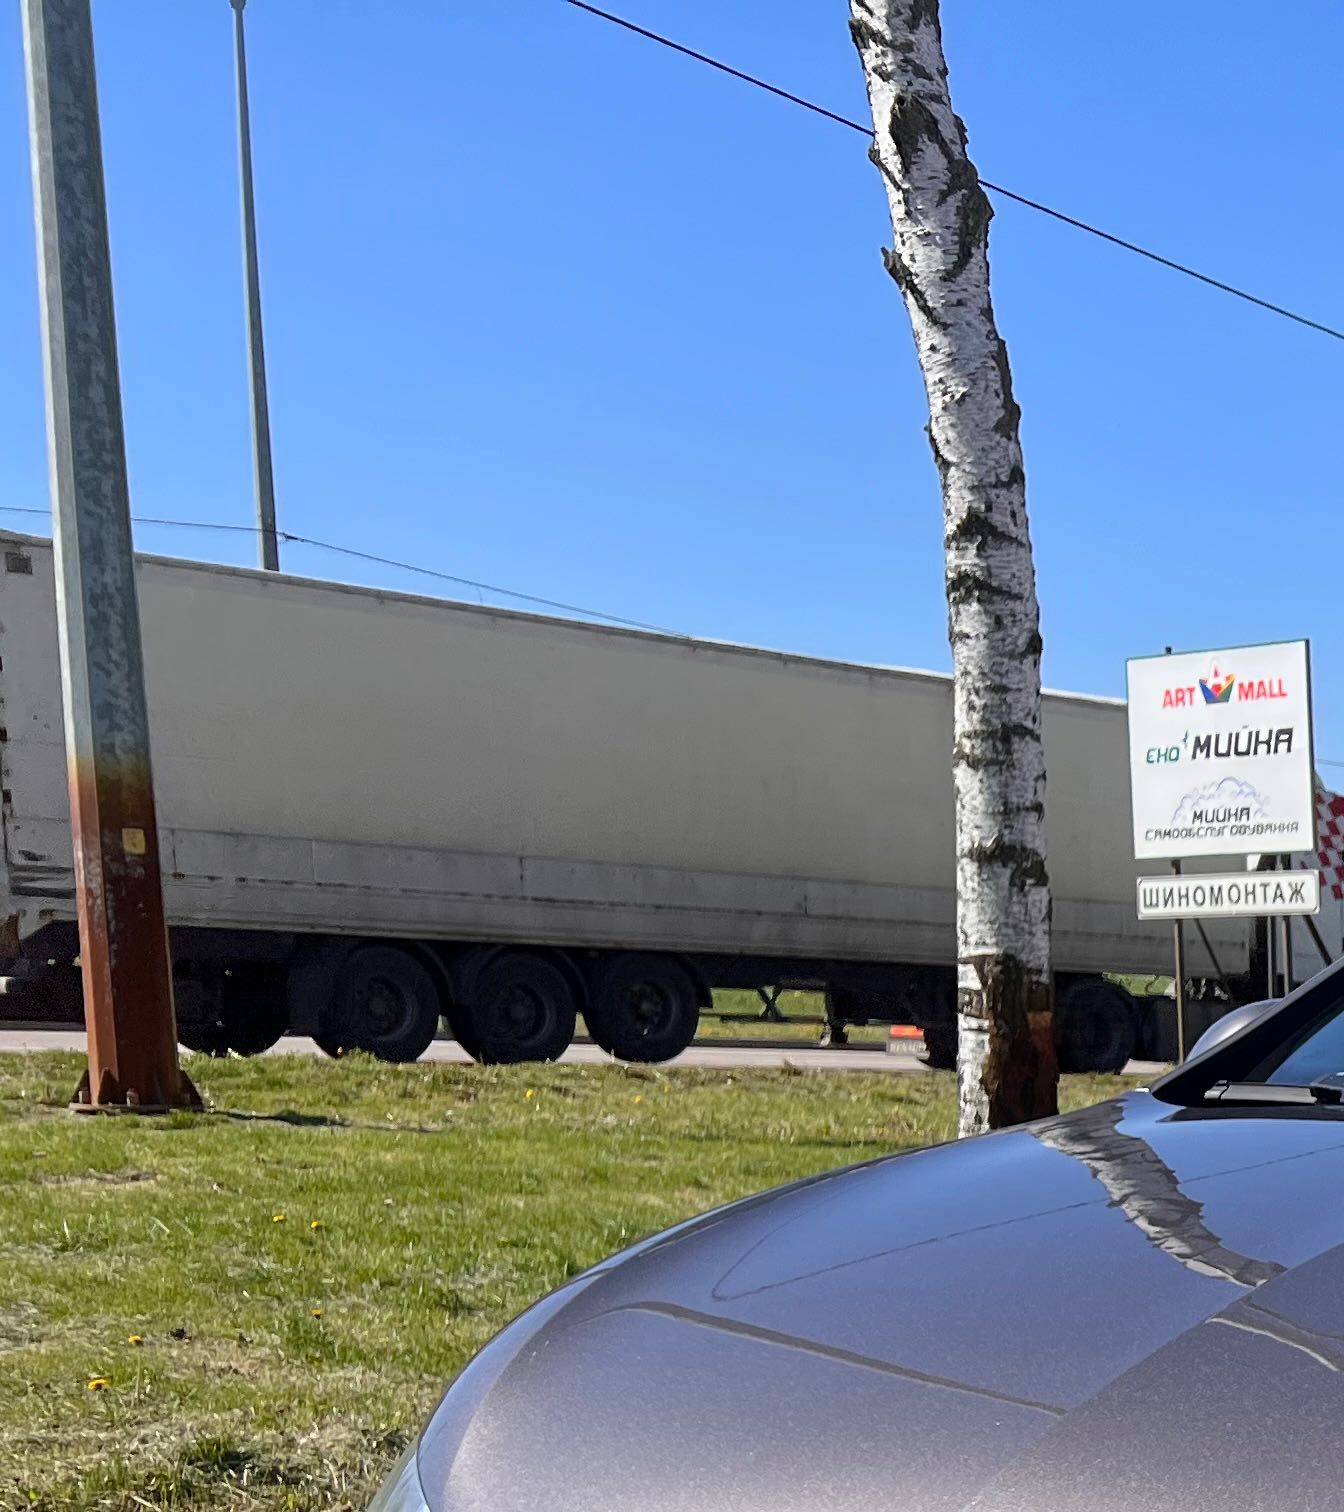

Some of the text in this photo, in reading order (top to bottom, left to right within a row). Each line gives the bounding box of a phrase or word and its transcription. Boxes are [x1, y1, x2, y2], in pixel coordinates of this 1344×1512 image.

[1163, 678, 1288, 709] ART MALL
[1191, 725, 1294, 760] МИЙКА
[1192, 805, 1251, 825] МИЙКА
[1143, 881, 1306, 908] ШИНОМОНТАЖ
